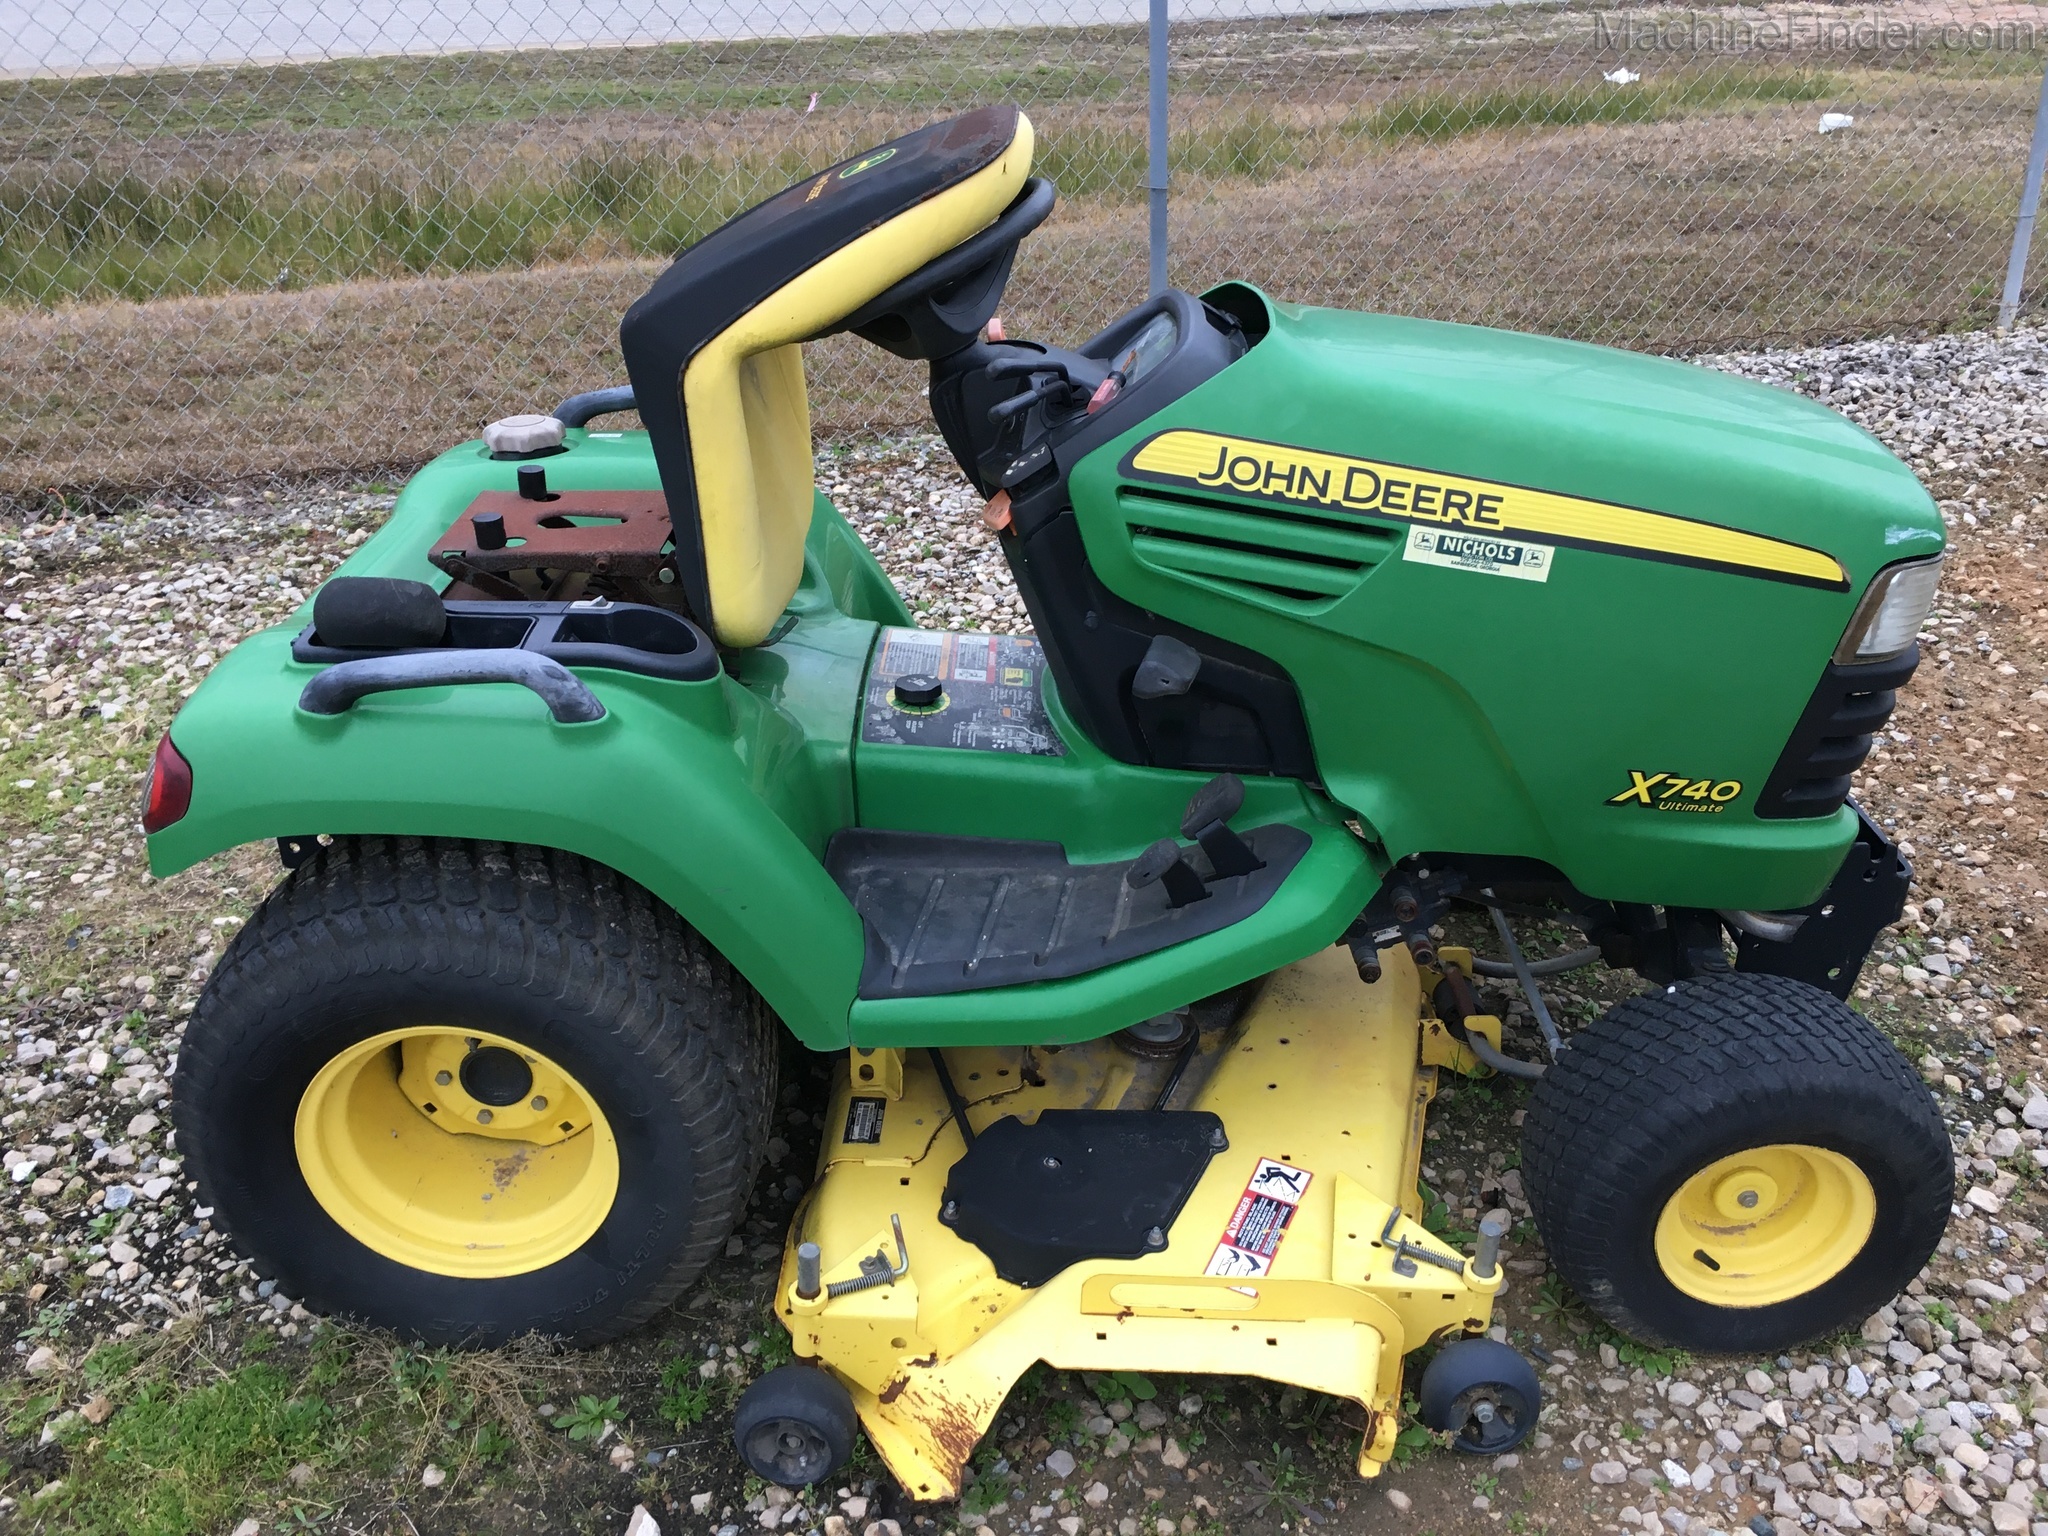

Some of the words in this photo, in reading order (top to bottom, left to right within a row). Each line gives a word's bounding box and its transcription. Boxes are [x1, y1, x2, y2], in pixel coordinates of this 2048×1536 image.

[1198, 446, 1332, 500] JOHN
[1342, 465, 1505, 526] DEERE
[1443, 537, 1516, 561] NICHOLS
[1610, 771, 1741, 803] X740
[1658, 801, 1724, 813] Ultimate
[1231, 1197, 1252, 1230] DANGER
